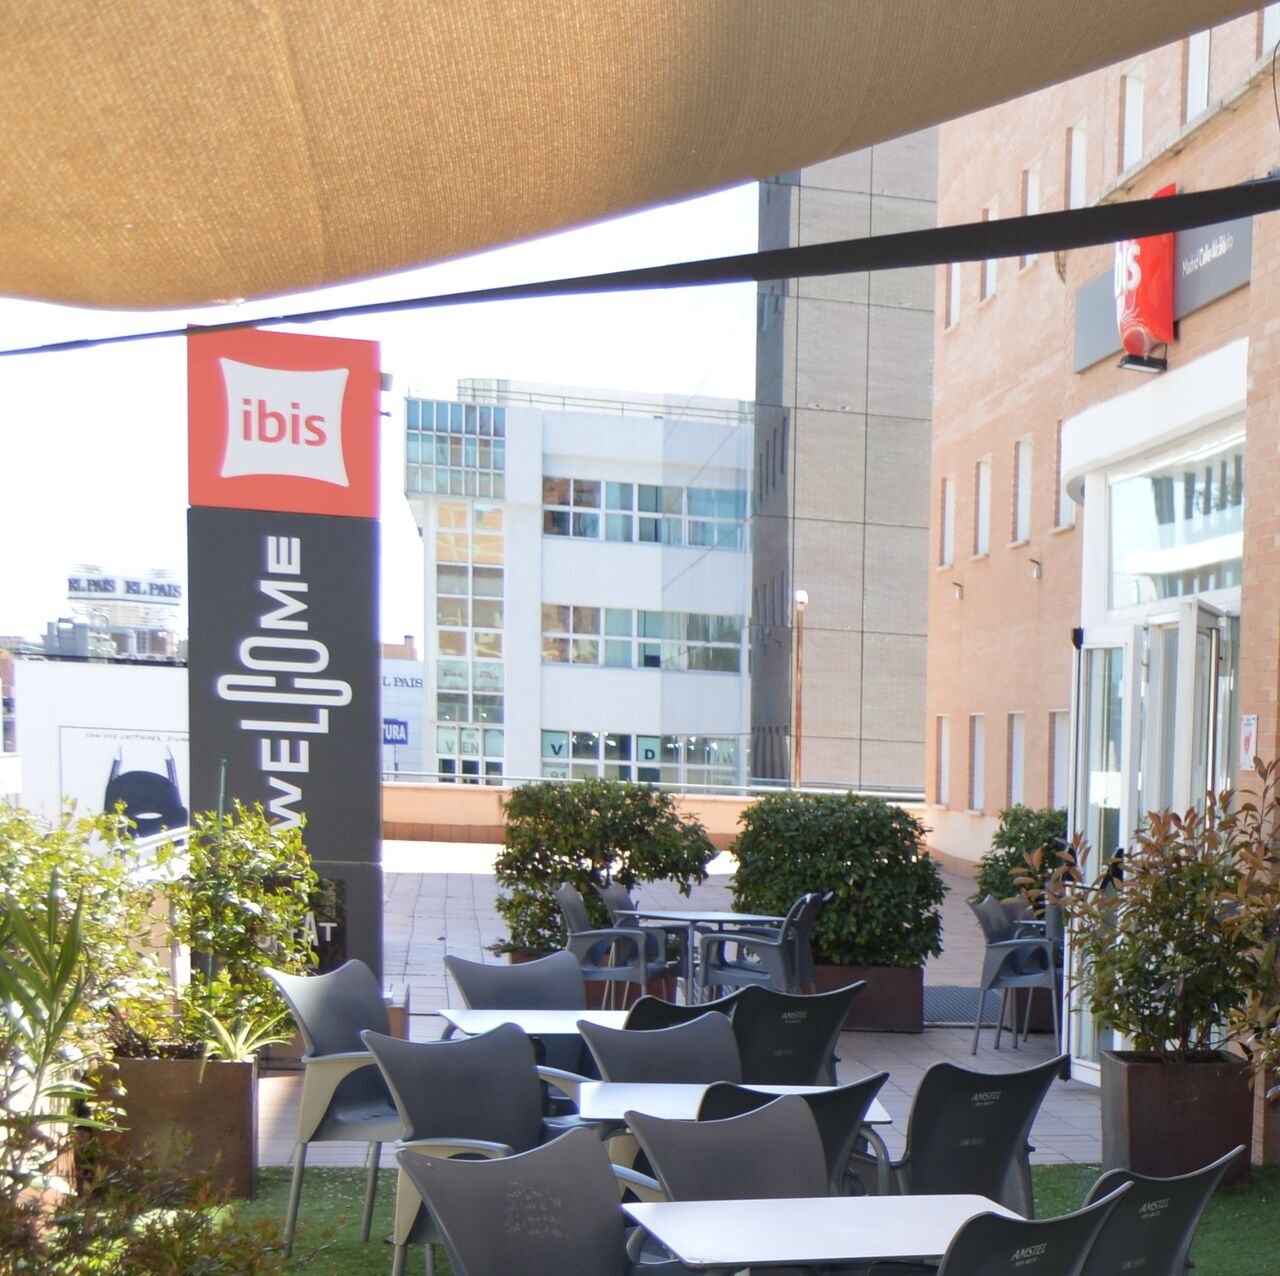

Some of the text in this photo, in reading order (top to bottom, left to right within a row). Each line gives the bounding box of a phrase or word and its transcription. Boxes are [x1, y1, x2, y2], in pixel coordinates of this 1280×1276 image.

[242, 397, 328, 448] ibis
[216, 534, 353, 834] WELCOME
[382, 724, 407, 741] URA
